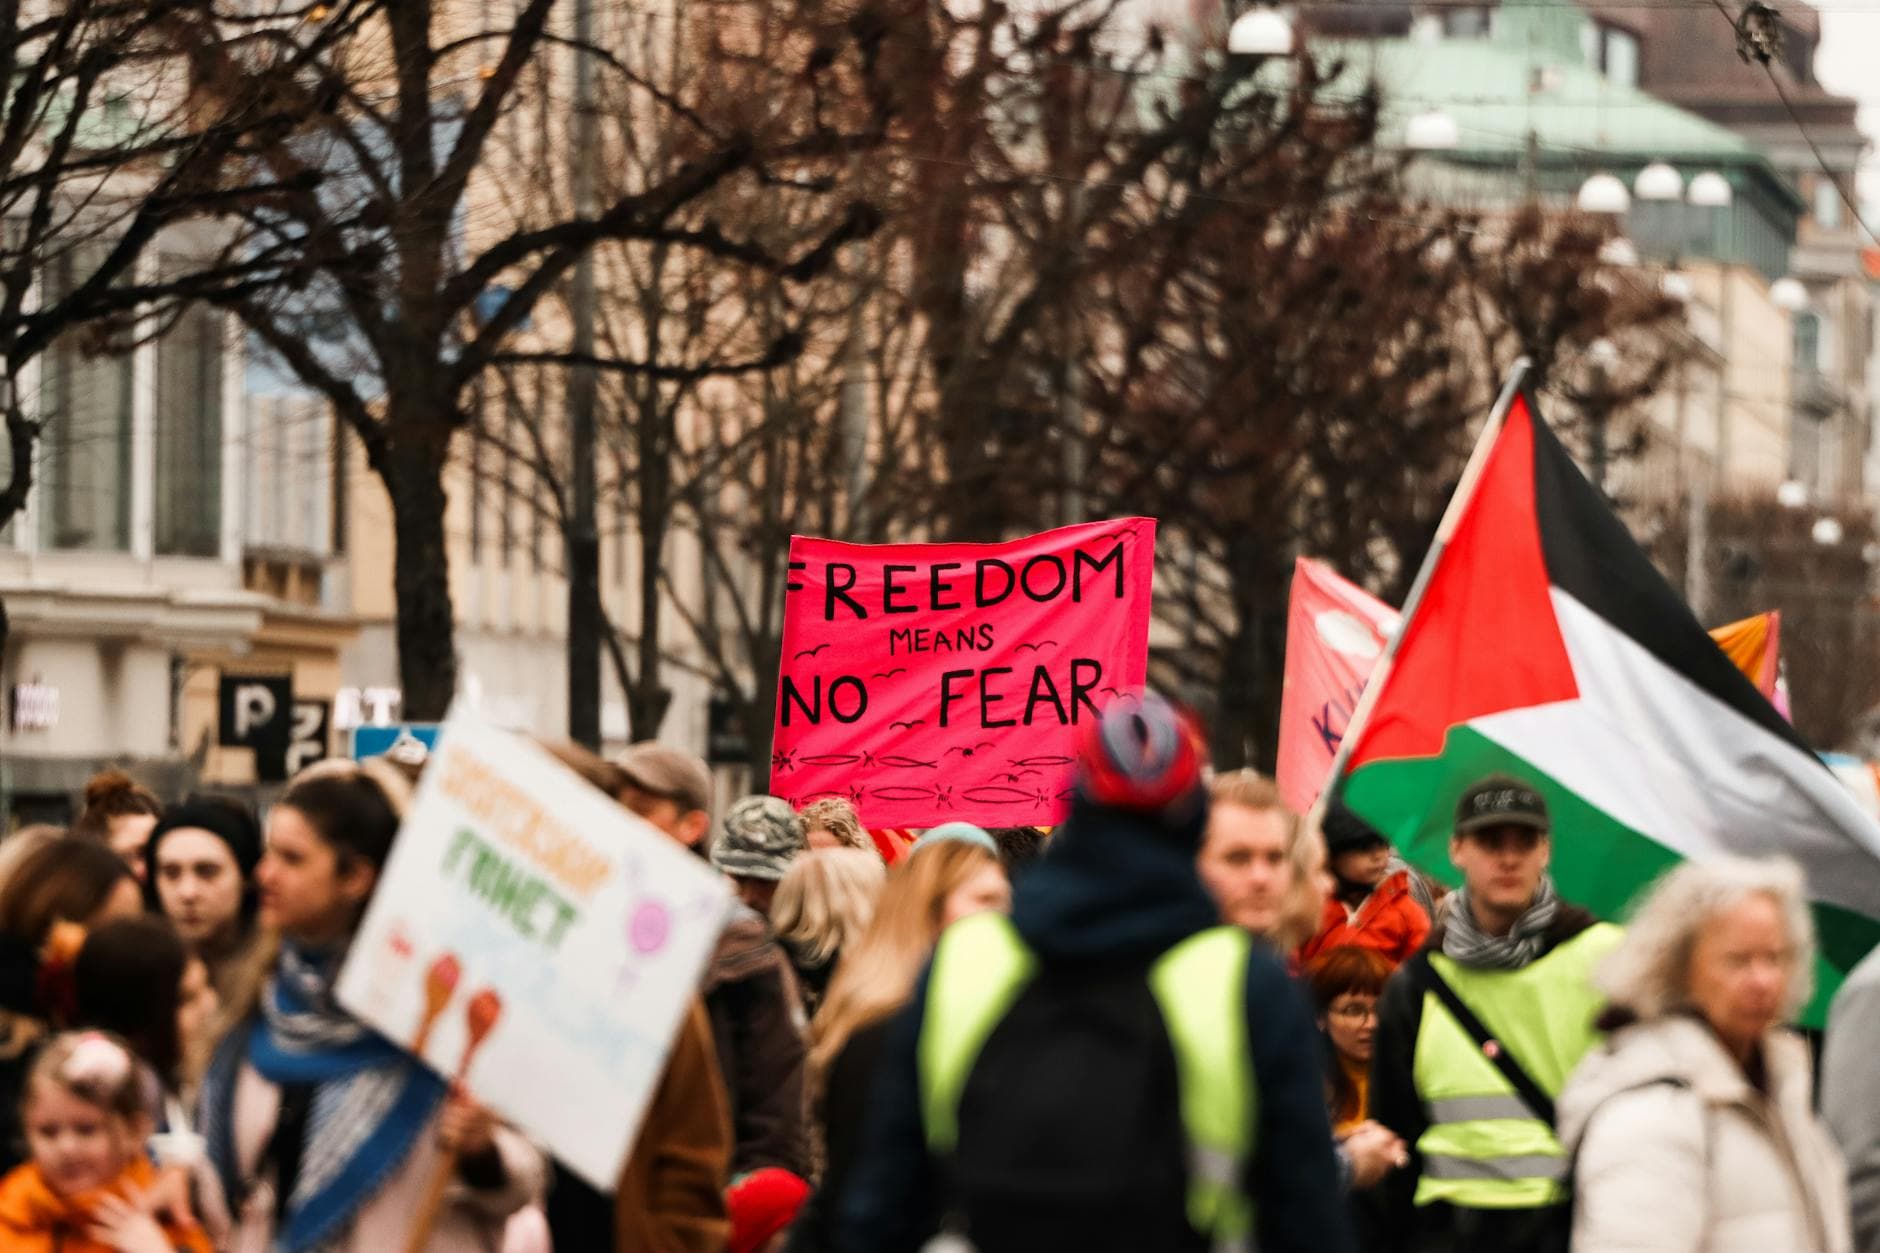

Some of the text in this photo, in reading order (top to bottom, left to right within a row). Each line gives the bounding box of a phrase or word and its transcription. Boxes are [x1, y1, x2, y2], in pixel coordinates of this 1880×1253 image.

[890, 624, 995, 656] MEANS
[781, 658, 1103, 729] NO FEAR
